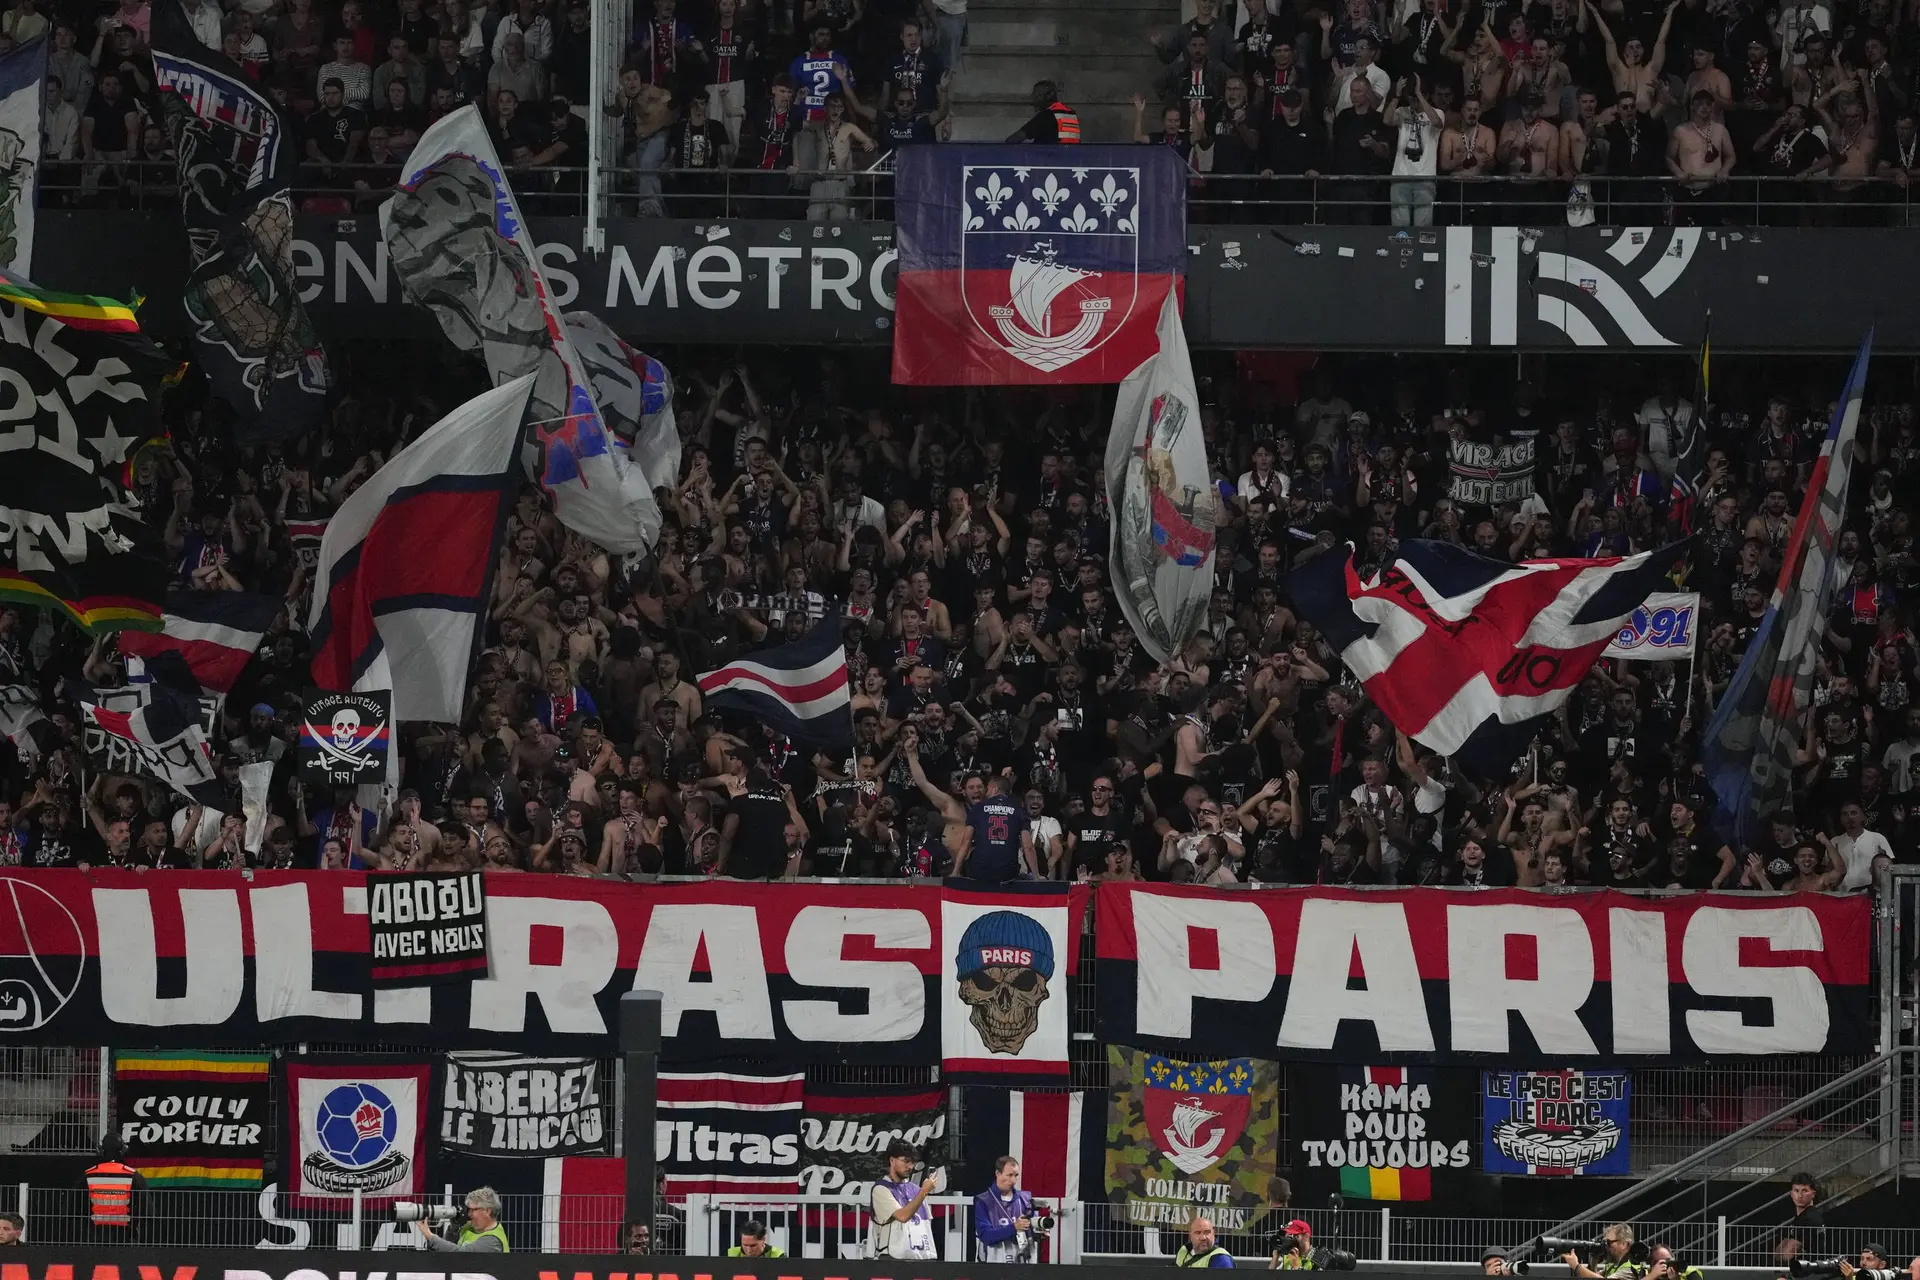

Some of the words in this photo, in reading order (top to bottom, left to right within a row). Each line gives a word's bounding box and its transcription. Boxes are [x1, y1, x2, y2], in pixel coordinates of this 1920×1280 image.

[812, 71, 830, 97] 2
[1450, 438, 1535, 468] VIRAGE
[1448, 474, 1535, 504] AUTEUIL
[1648, 606, 1693, 648] 91
[328, 771, 355, 784] 1991
[983, 804, 1015, 815] CHAMPIONS
[987, 816, 1009, 841] 25
[371, 873, 483, 925] ABDOU
[373, 929, 427, 958] AVEC
[430, 923, 484, 955] NOUS
[981, 947, 1032, 968] PARIS
[1131, 890, 1830, 1055] PARIS
[443, 1060, 600, 1116] LIBEREZ
[1340, 1083, 1431, 1113] KAMA
[1487, 1074, 1511, 1098] LE
[1516, 1076, 1562, 1100] PSG
[133, 1094, 249, 1120] COULY
[1510, 1099, 1536, 1124] LE
[1540, 1100, 1601, 1126] PARC
[121, 1120, 262, 1146] FOREVER
[441, 1110, 475, 1146] LE
[1346, 1111, 1427, 1141] POUR
[1302, 1140, 1471, 1169] TOUJOURS
[1145, 1177, 1232, 1204] COLLECTIF
[1130, 1199, 1191, 1225] ULTRAS
[1196, 1207, 1246, 1231] PARIS
